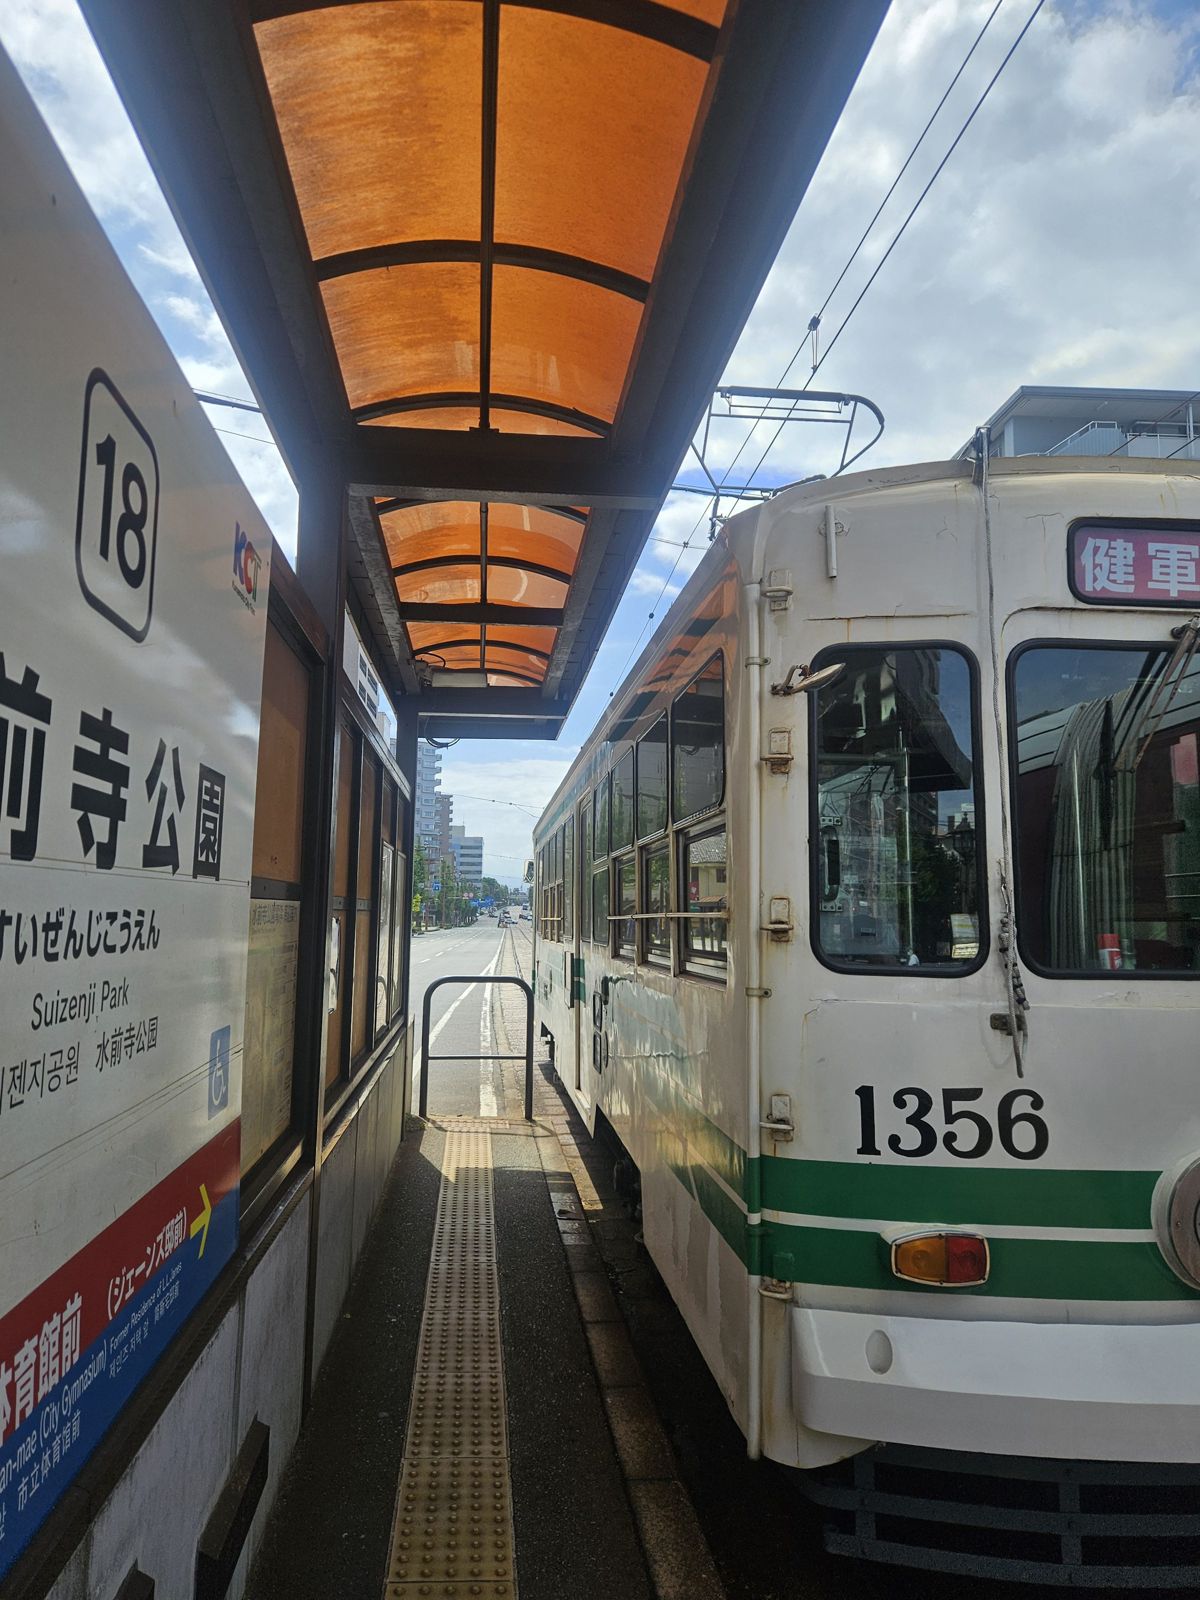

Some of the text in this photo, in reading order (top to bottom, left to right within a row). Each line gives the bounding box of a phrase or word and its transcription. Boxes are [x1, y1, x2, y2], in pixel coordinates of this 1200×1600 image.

[96, 434, 149, 590] 18
[233, 520, 262, 602] KCT
[1081, 537, 1200, 597] 健軍
[31, 977, 130, 1031] Suizenji Park
[855, 1085, 1049, 1160] 1356
[109, 1321, 130, 1352] Former
[39, 1400, 60, 1448] (City
[61, 1338, 107, 1417] Gymnasium)
